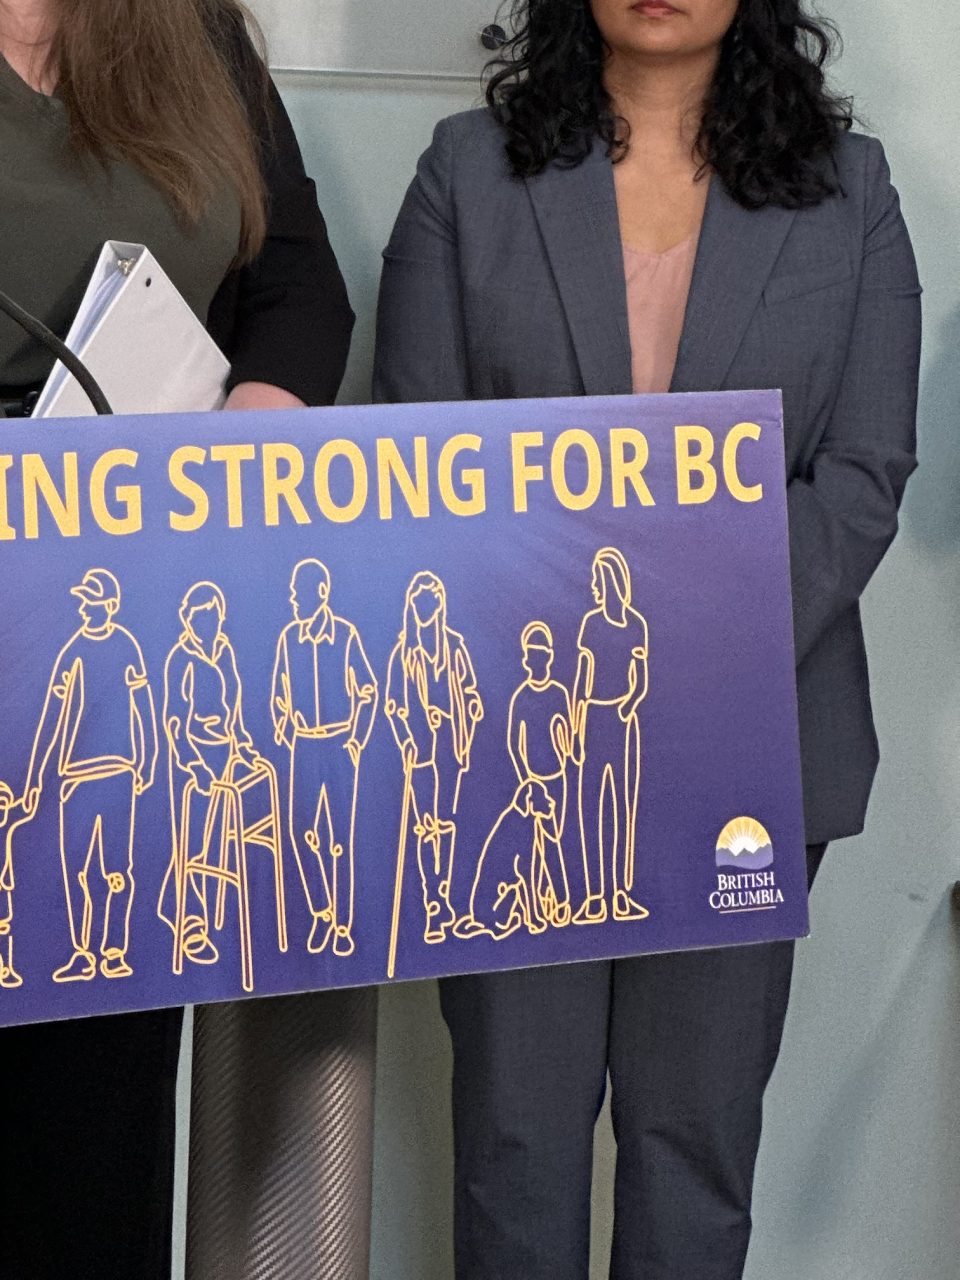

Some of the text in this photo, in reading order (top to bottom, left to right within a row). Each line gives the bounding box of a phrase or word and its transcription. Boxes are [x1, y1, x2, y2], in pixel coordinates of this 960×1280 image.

[167, 433, 487, 531] STRONG
[510, 428, 656, 513] FOR
[673, 422, 763, 505] BC
[717, 871, 775, 891] BRITISH
[708, 888, 785, 909] COLUMBIA
